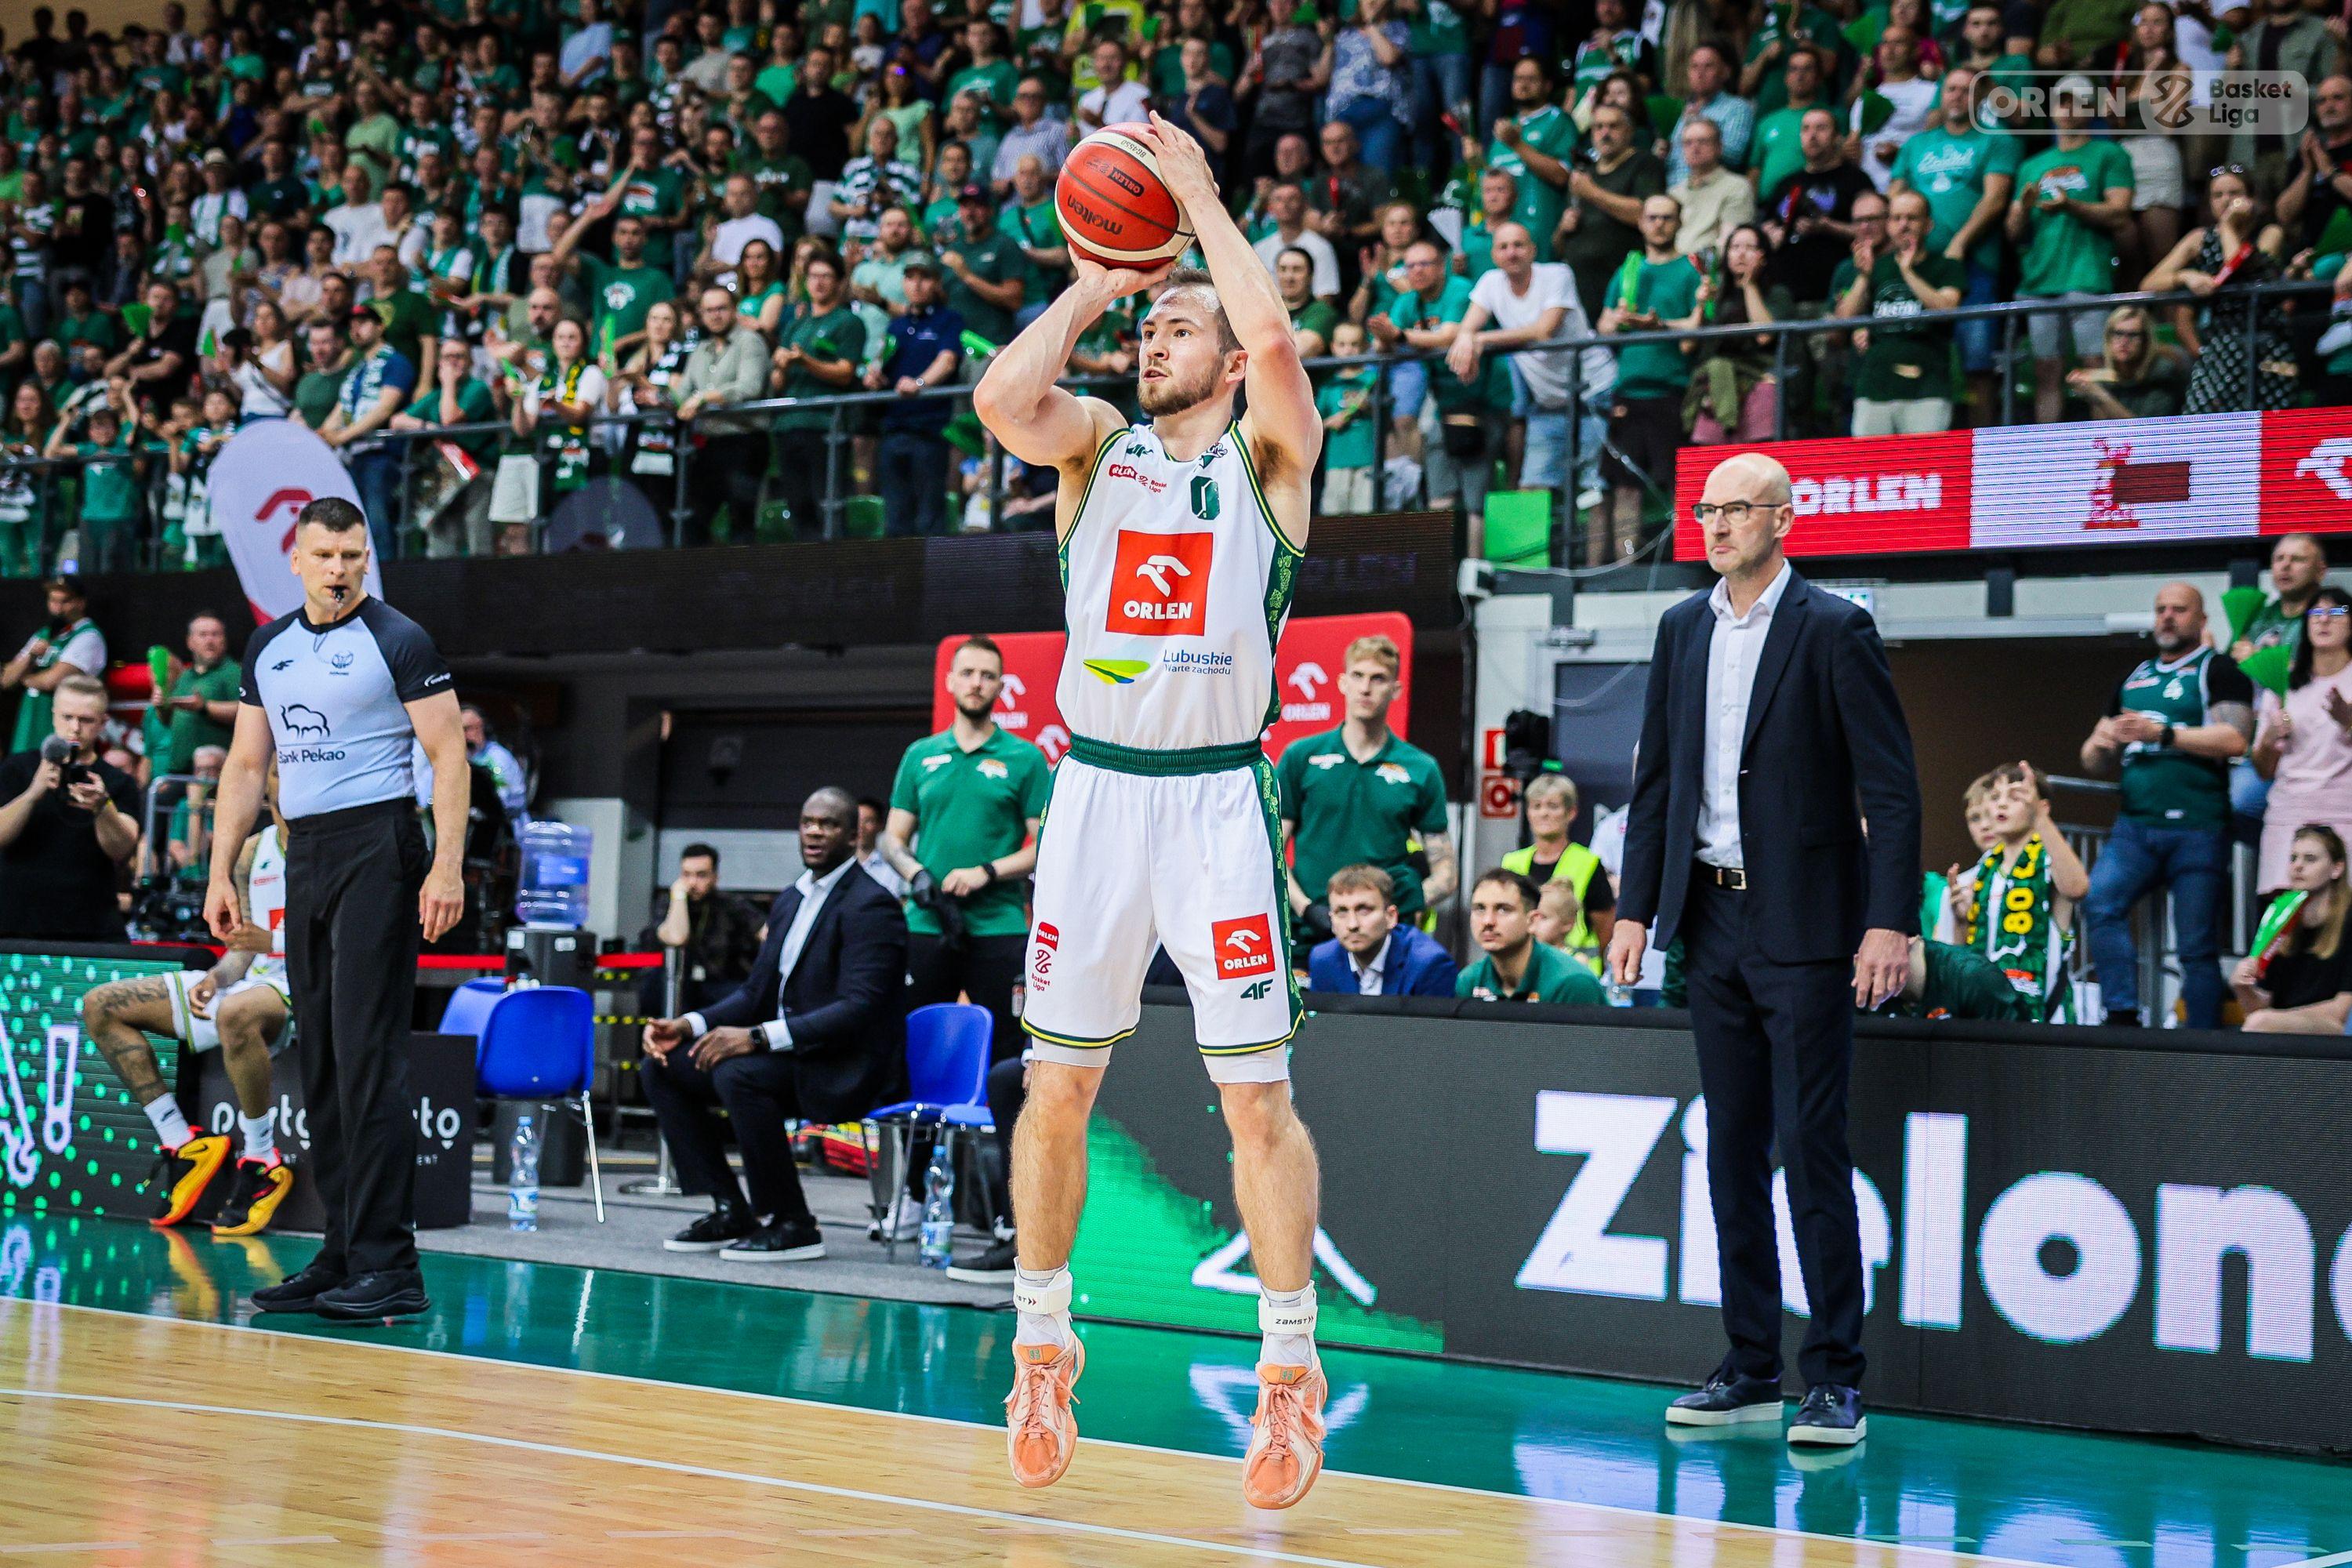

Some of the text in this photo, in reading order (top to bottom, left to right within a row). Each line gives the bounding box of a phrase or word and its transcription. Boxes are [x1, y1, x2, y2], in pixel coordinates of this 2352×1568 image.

[1112, 171, 1141, 194] ORLEN
[1067, 194, 1123, 235] molten
[1791, 473, 1942, 516] ORLEN
[1123, 600, 1193, 620] ORLEN
[1163, 648, 1232, 666] Lubuskie
[1192, 666, 1231, 675] zachodu
[301, 748, 346, 762] Pekao
[1037, 929, 1058, 942] ORLEN
[1224, 953, 1268, 971] ORLEN
[1031, 972, 1051, 986] Basket
[1033, 982, 1045, 992] Liga
[1240, 978, 1273, 1000] 4F
[1514, 1089, 2352, 1363] Zilon
